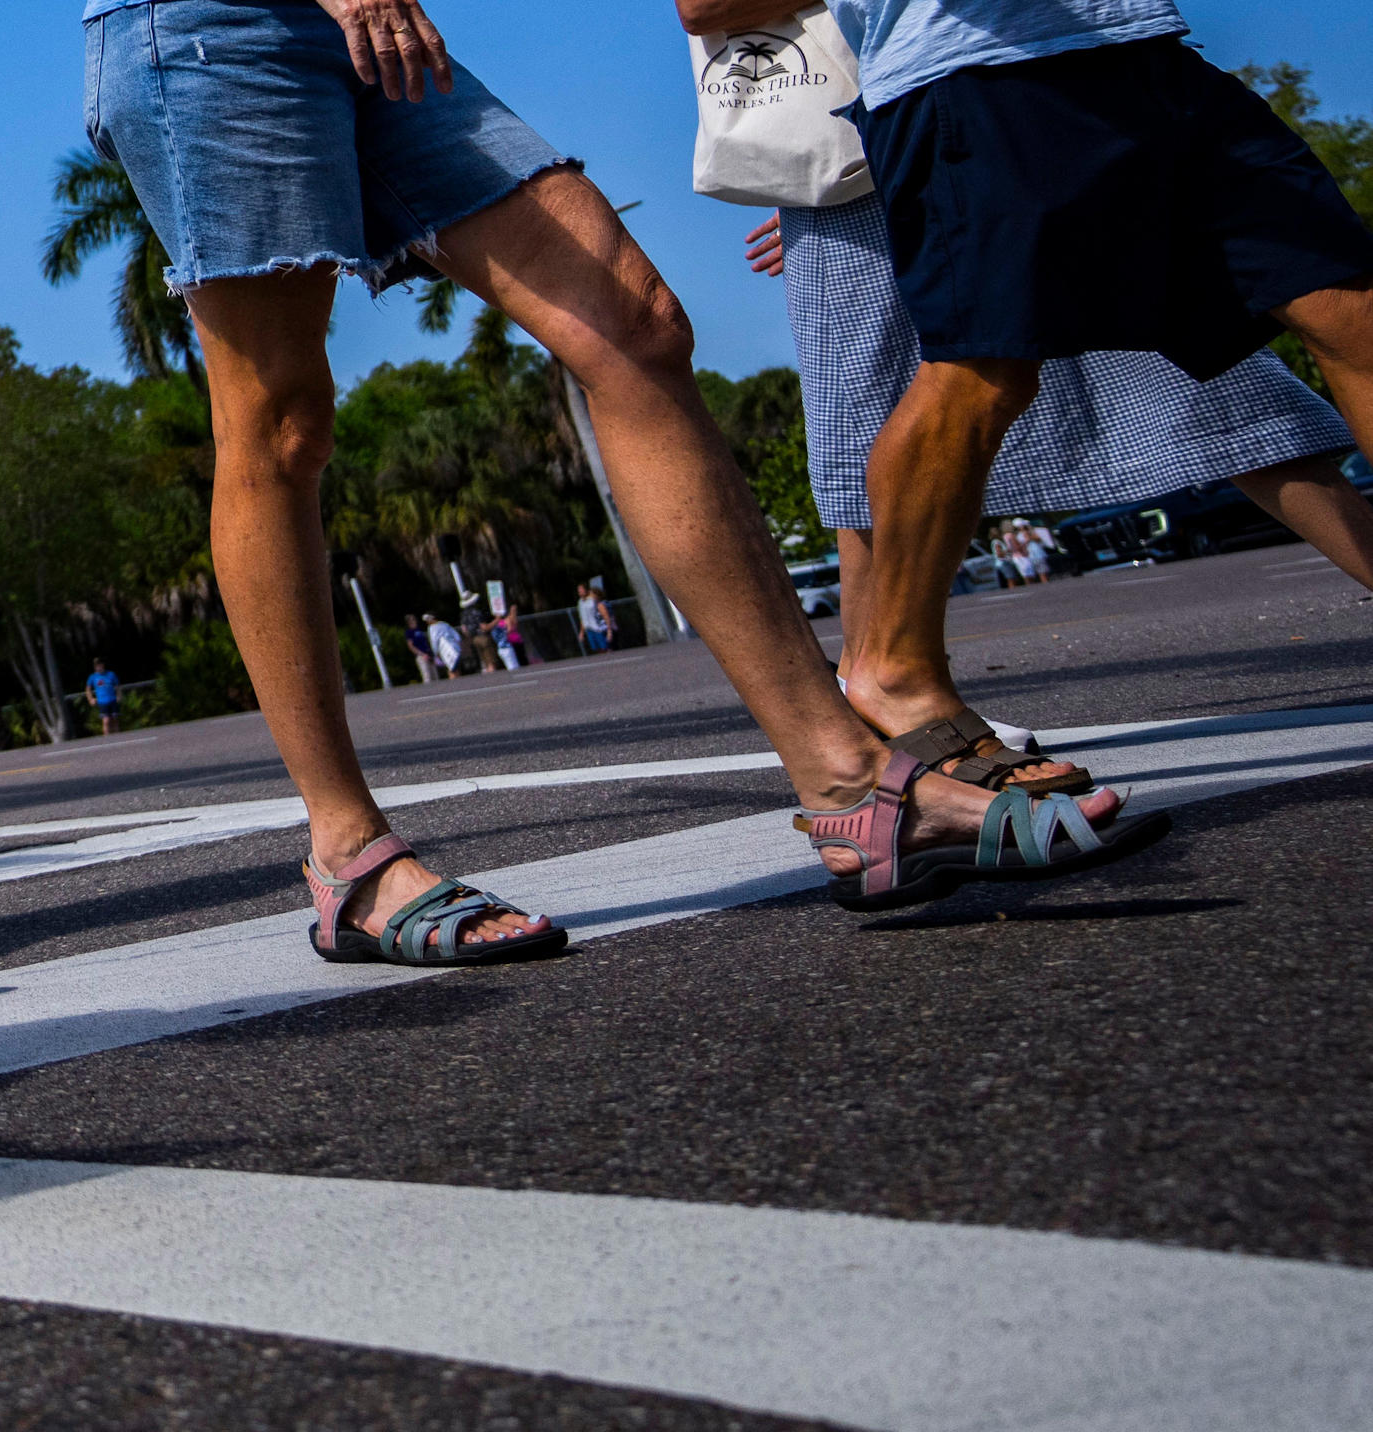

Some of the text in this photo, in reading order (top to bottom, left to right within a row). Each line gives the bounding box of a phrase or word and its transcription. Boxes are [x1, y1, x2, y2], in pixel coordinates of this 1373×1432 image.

[697, 73, 828, 96] OOKS ON THIRD
[769, 94, 784, 104] FL
